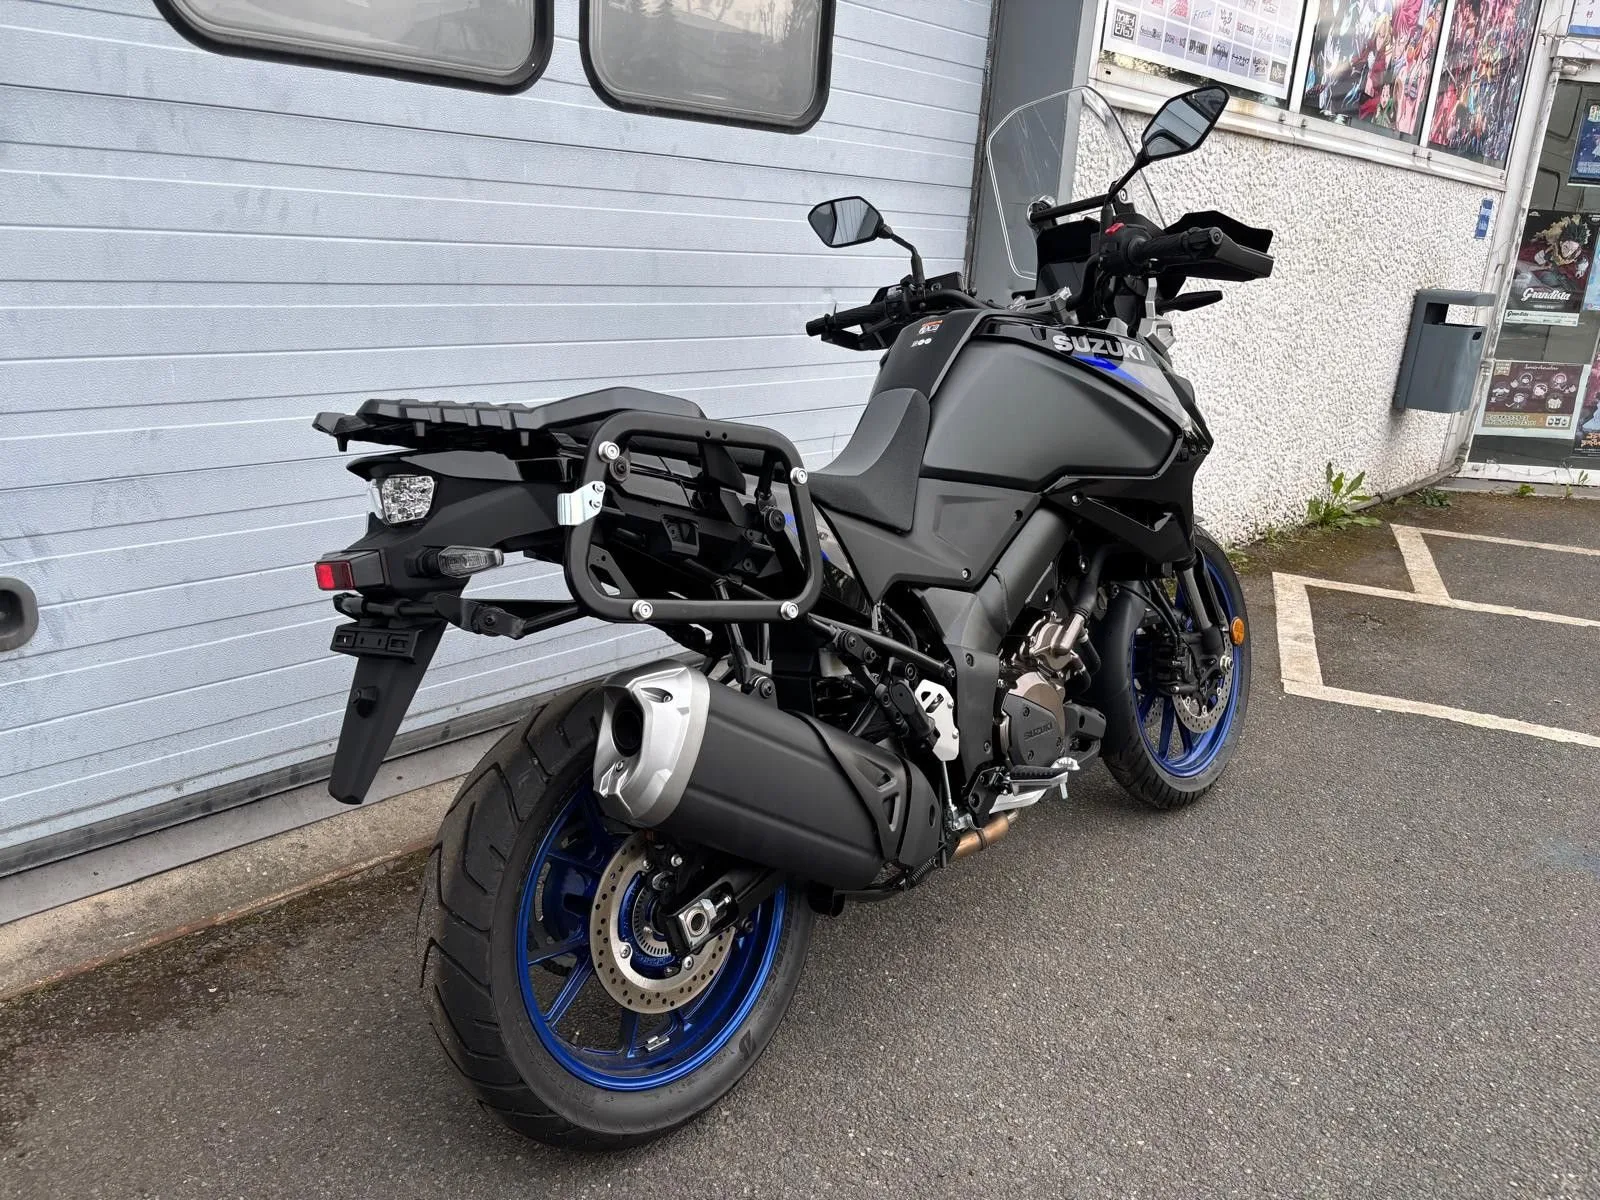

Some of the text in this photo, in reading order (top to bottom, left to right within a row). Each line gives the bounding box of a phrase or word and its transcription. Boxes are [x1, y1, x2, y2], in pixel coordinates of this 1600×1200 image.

[1521, 287, 1571, 301] Grandista
[1052, 334, 1146, 361] SUZUKI
[1024, 722, 1053, 739] SUZUKI
